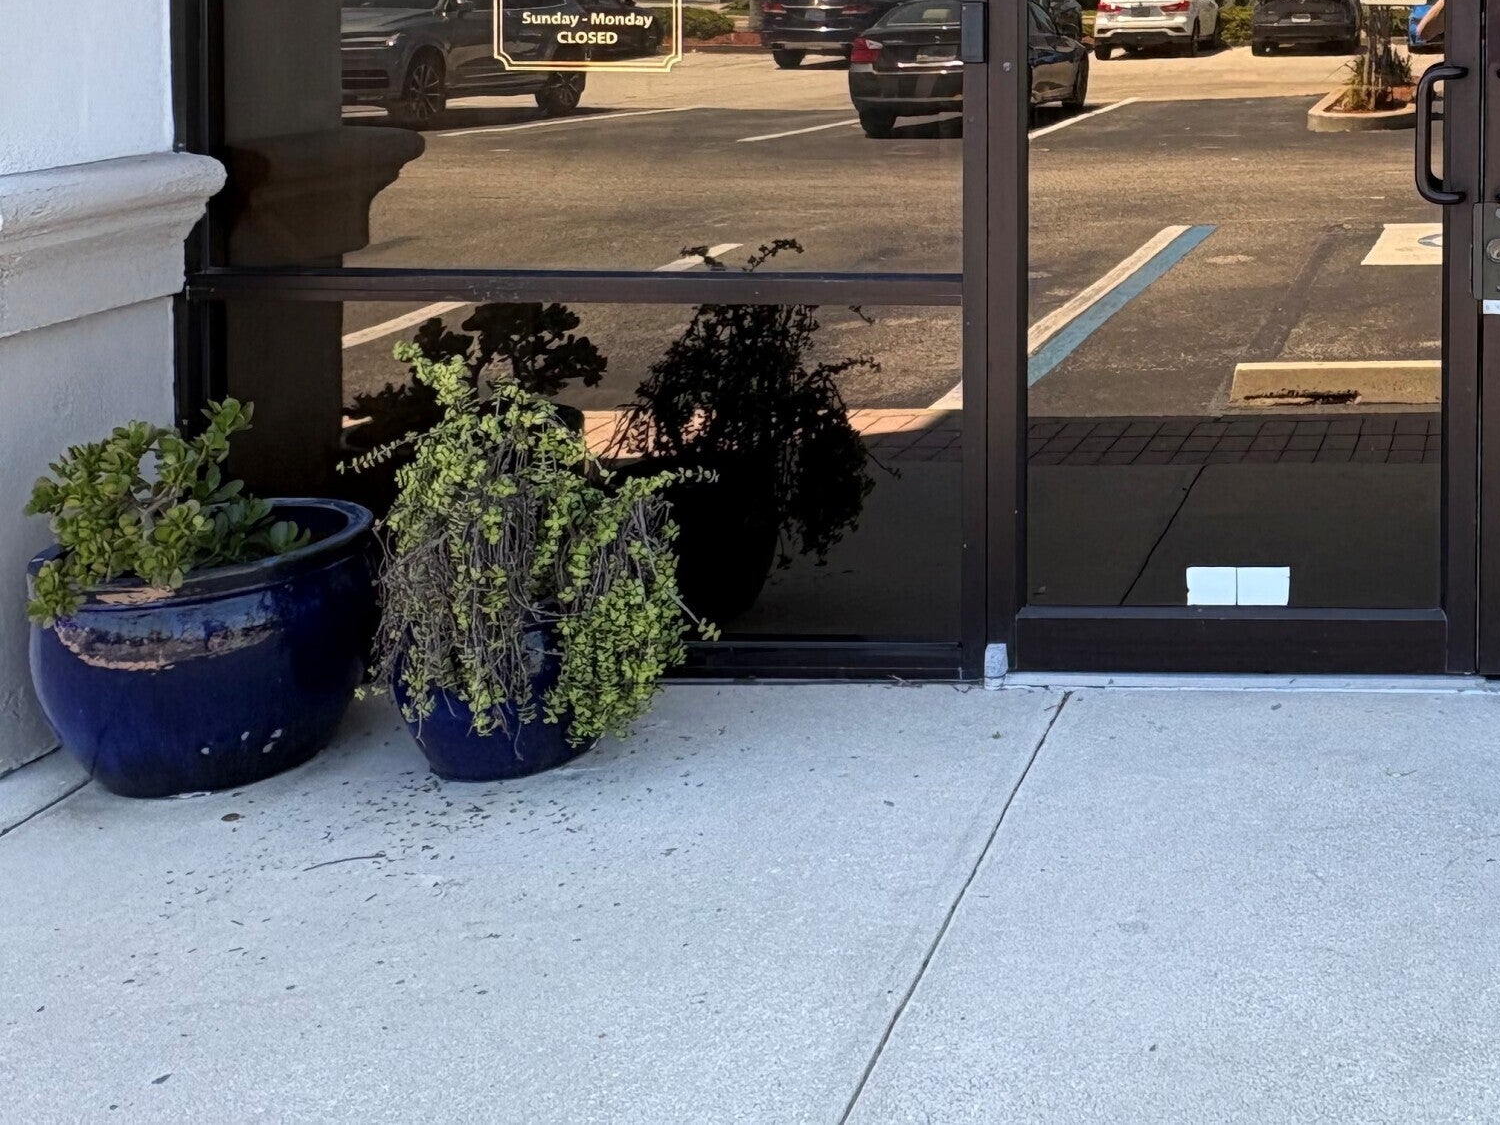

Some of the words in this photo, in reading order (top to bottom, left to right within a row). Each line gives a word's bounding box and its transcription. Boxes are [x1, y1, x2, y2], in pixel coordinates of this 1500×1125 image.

[522, 11, 580, 28] Sunday
[591, 12, 653, 29] Monday
[557, 31, 618, 45] CLOSED
